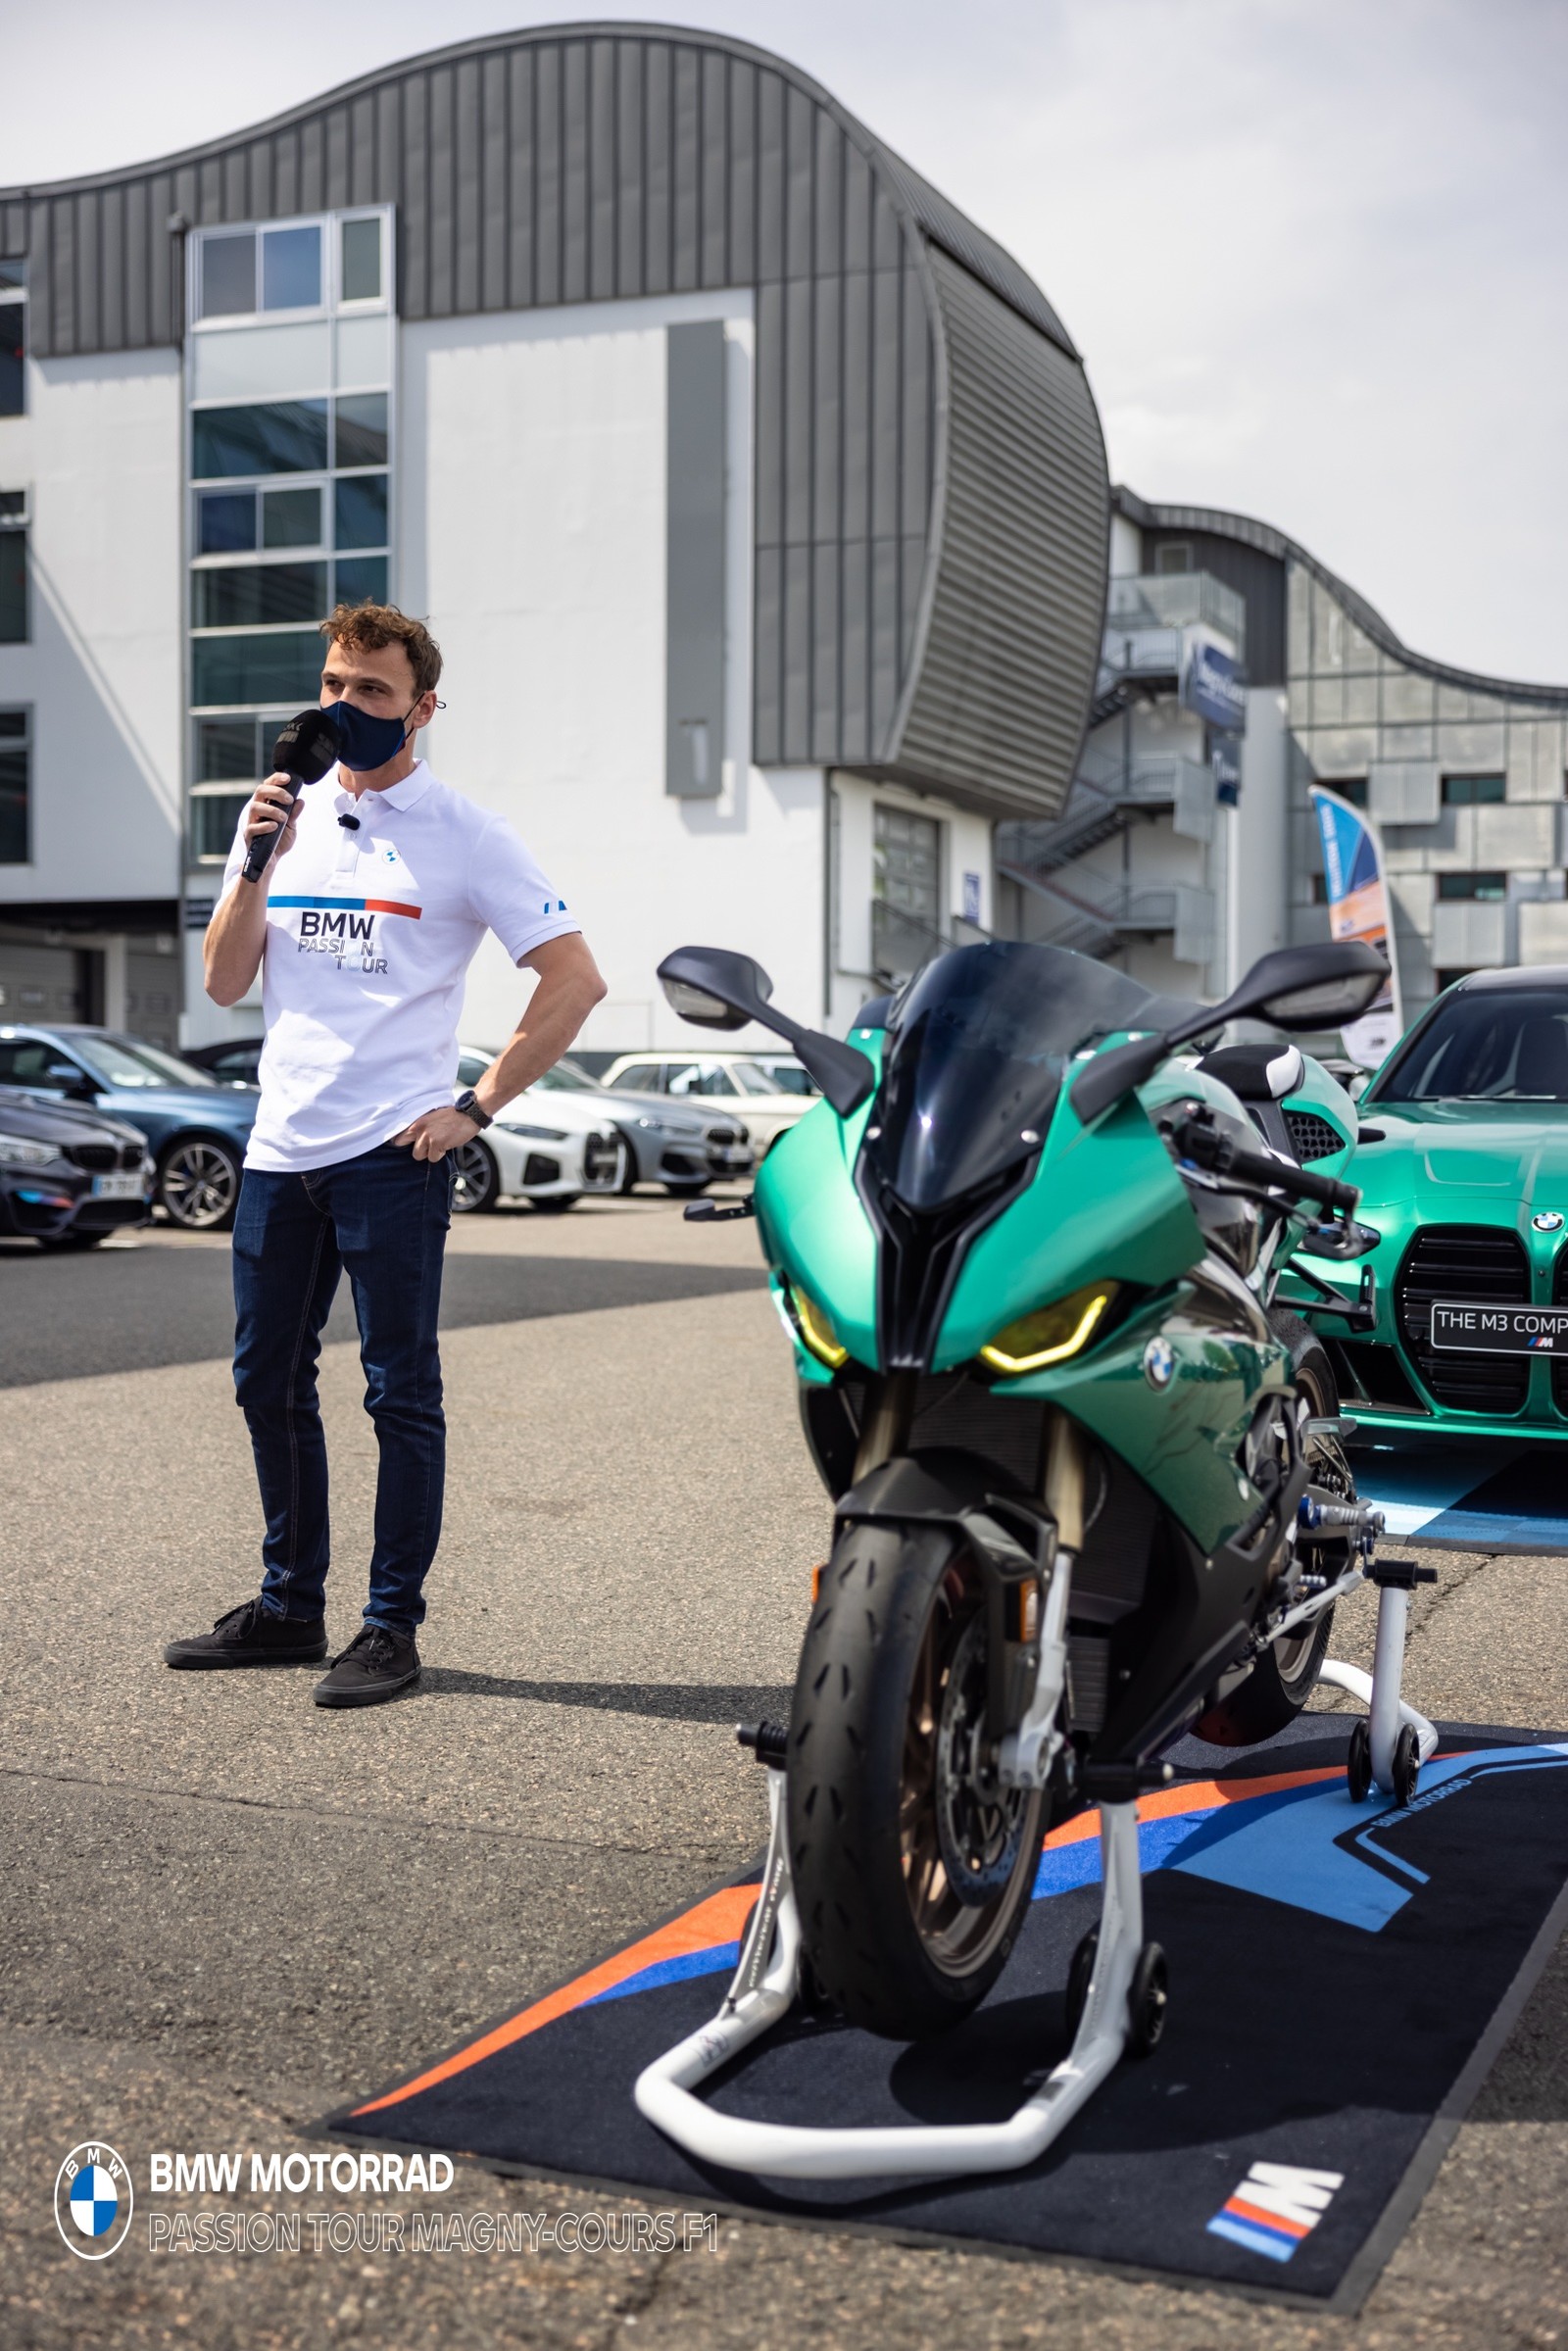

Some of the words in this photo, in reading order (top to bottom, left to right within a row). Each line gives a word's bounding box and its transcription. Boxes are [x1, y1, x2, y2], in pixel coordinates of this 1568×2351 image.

[300, 911, 375, 940] BMW
[298, 938, 373, 956] PASSIN
[1437, 1311, 1476, 1329] THE
[1481, 1314, 1508, 1332] M3
[1513, 1315, 1568, 1334] COMP
[1406, 1779, 1472, 1812] MOTORRAD
